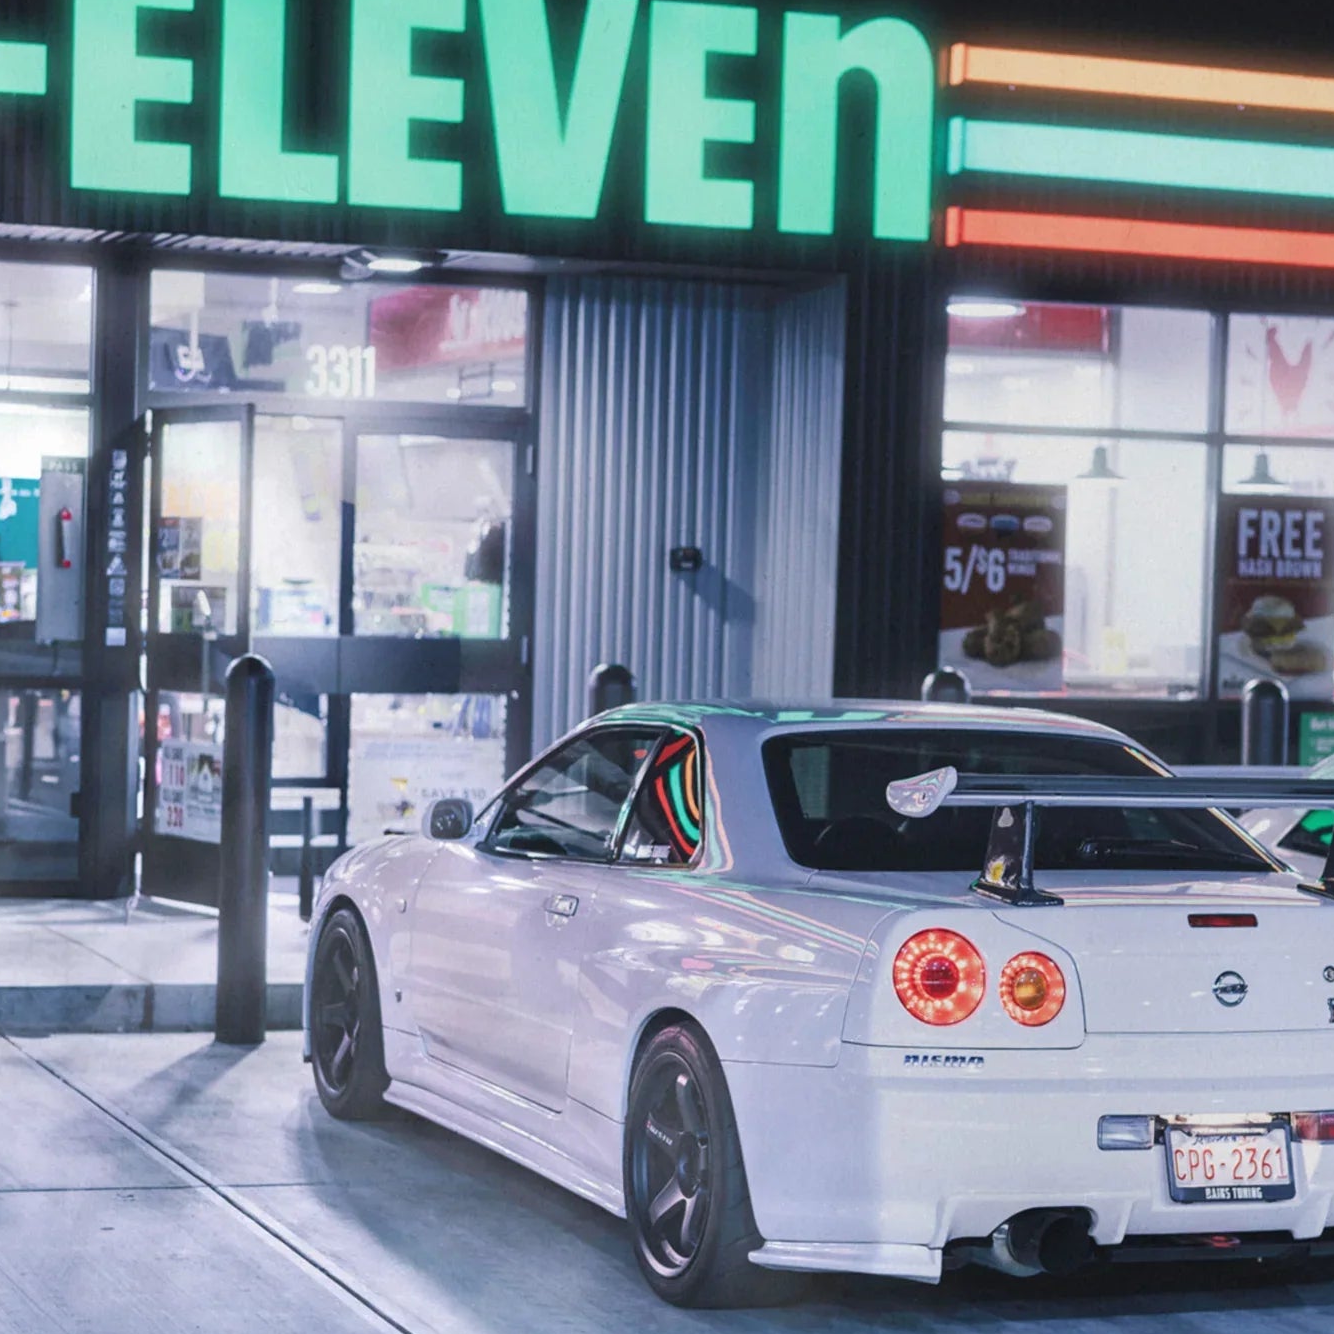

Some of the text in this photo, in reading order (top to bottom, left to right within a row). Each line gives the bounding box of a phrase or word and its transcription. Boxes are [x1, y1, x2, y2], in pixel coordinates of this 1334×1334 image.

[305, 345, 376, 398] 3311
[1238, 509, 1325, 560] FREE
[1174, 1148, 1288, 1181] CPG-2361
